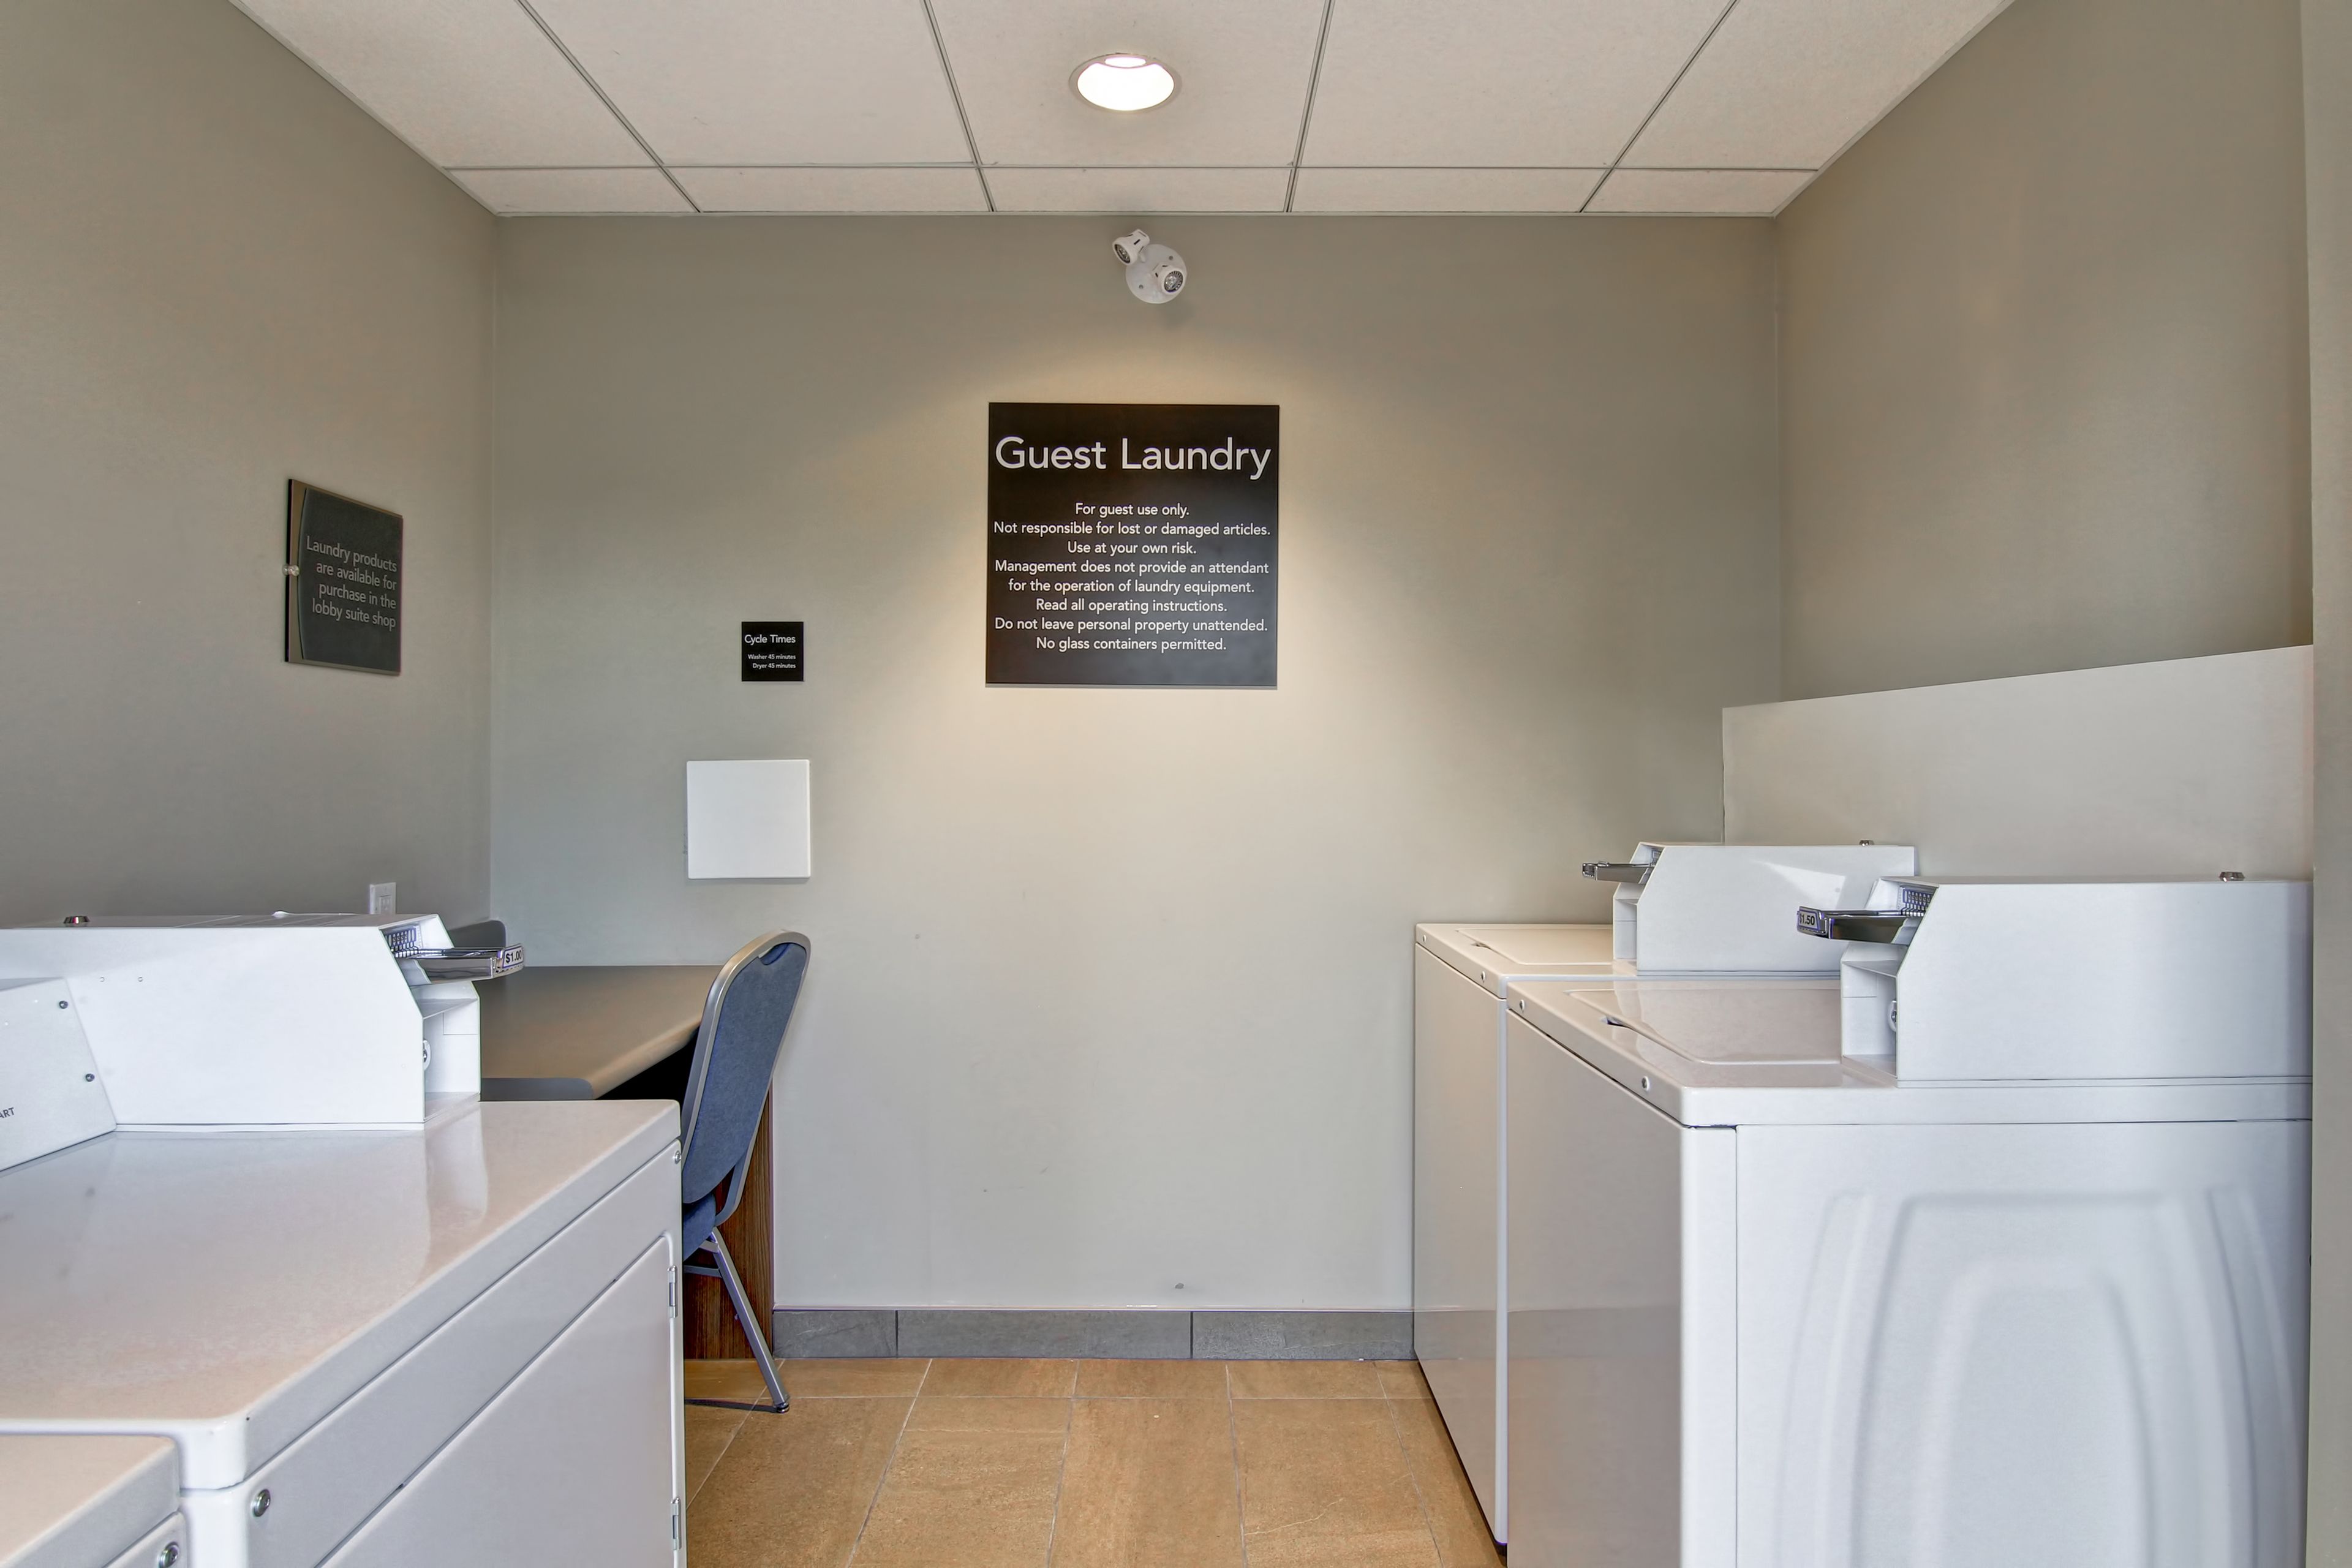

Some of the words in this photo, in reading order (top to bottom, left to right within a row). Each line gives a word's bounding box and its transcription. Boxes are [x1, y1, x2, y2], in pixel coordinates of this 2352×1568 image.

[995, 436, 1106, 469] Guest
[1122, 437, 1271, 480] Laundry
[1076, 502, 1096, 514] For
[1099, 504, 1134, 518] guest
[1137, 506, 1158, 515] use
[1161, 502, 1189, 519] only.
[994, 521, 1017, 533] Not
[1022, 521, 1093, 537] responsible
[1096, 521, 1115, 534] for
[1118, 521, 1140, 534] lost
[1144, 526, 1158, 535] or
[1161, 522, 1219, 538] damaged
[1223, 522, 1270, 535] articles.
[306, 535, 350, 564] Laundry
[353, 552, 397, 572] products
[1068, 541, 1091, 553] Use
[1094, 543, 1107, 553] at
[1110, 545, 1139, 557] your
[1142, 545, 1168, 554] own
[1172, 541, 1197, 554] risk.
[317, 562, 334, 575] are
[337, 568, 380, 586] available
[383, 575, 397, 590] for
[995, 559, 1077, 575] Management
[1080, 559, 1111, 573] does
[1114, 562, 1136, 573] not
[1139, 560, 1187, 576] provide
[1190, 564, 1205, 573] an
[1208, 560, 1269, 574] attendant
[1008, 578, 1027, 591] for
[1030, 578, 1051, 591] the
[1054, 579, 1115, 595] operation
[1118, 579, 1132, 592] of
[1134, 579, 1181, 596] laundry
[1183, 580, 1254, 596] equipment.
[319, 584, 366, 603] purchase
[369, 591, 377, 605] in
[380, 594, 396, 609] the
[312, 598, 342, 621] lobby
[345, 608, 369, 622] suite
[372, 611, 396, 631] shop
[1036, 598, 1068, 611] Read
[1071, 598, 1085, 611] all
[1088, 599, 1149, 615] operating
[1153, 599, 1227, 612] instructions.
[995, 617, 1013, 629] Do
[1017, 619, 1038, 630] not
[1041, 617, 1074, 630] leave
[1077, 617, 1131, 634] personal
[1134, 620, 1189, 635] property
[1193, 618, 1268, 631] unattended.
[744, 634, 767, 646] Cycle
[769, 634, 796, 643] Times
[1036, 636, 1055, 649] No
[1058, 636, 1090, 652] glass
[1093, 637, 1158, 650] containers
[1161, 637, 1227, 654] permitted.
[1800, 913, 1815, 925] $1.50
